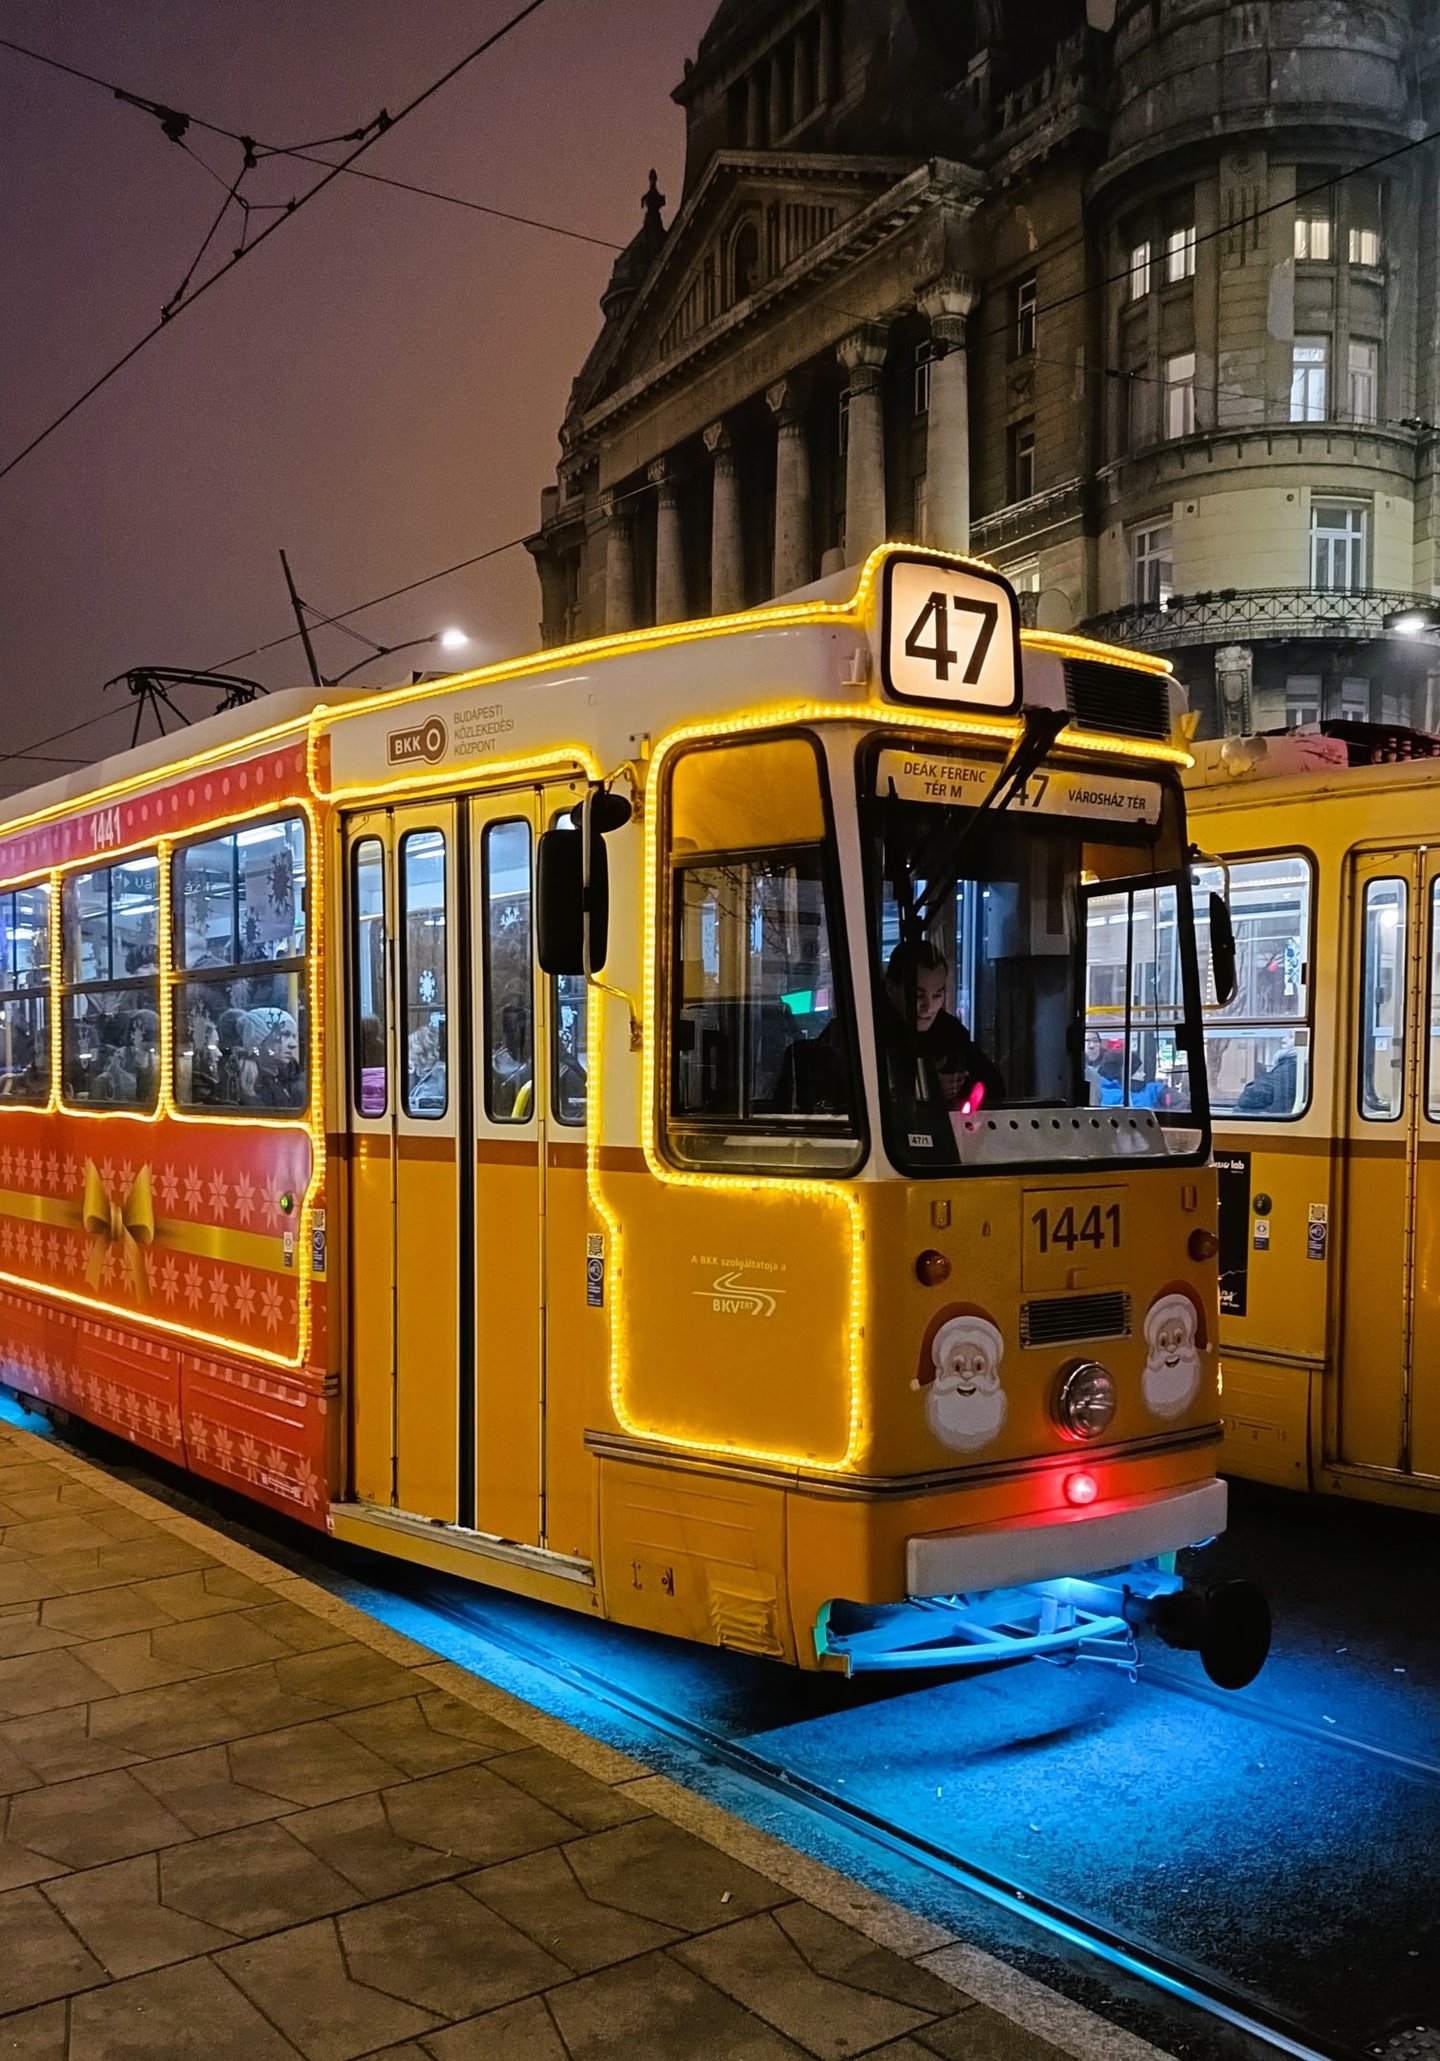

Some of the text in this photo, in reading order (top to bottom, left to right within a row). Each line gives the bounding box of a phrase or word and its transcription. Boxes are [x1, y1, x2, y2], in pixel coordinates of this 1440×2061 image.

[905, 592, 998, 685] 47
[454, 704, 503, 725] BUDAPESTI
[454, 718, 514, 740] KÖZLEKEDÉSI
[395, 736, 421, 755] BKK
[454, 738, 496, 756] KÖZPONT
[904, 761, 986, 783] DEÁK FERENC
[924, 780, 962, 798] TÉR M
[1068, 788, 1146, 810] VÁROSHÁZ TÉR
[90, 806, 120, 851] 1441
[1031, 1204, 1120, 1253] 1441
[691, 1255, 698, 1264] A
[700, 1256, 719, 1266] BKK
[781, 1263, 787, 1272] a
